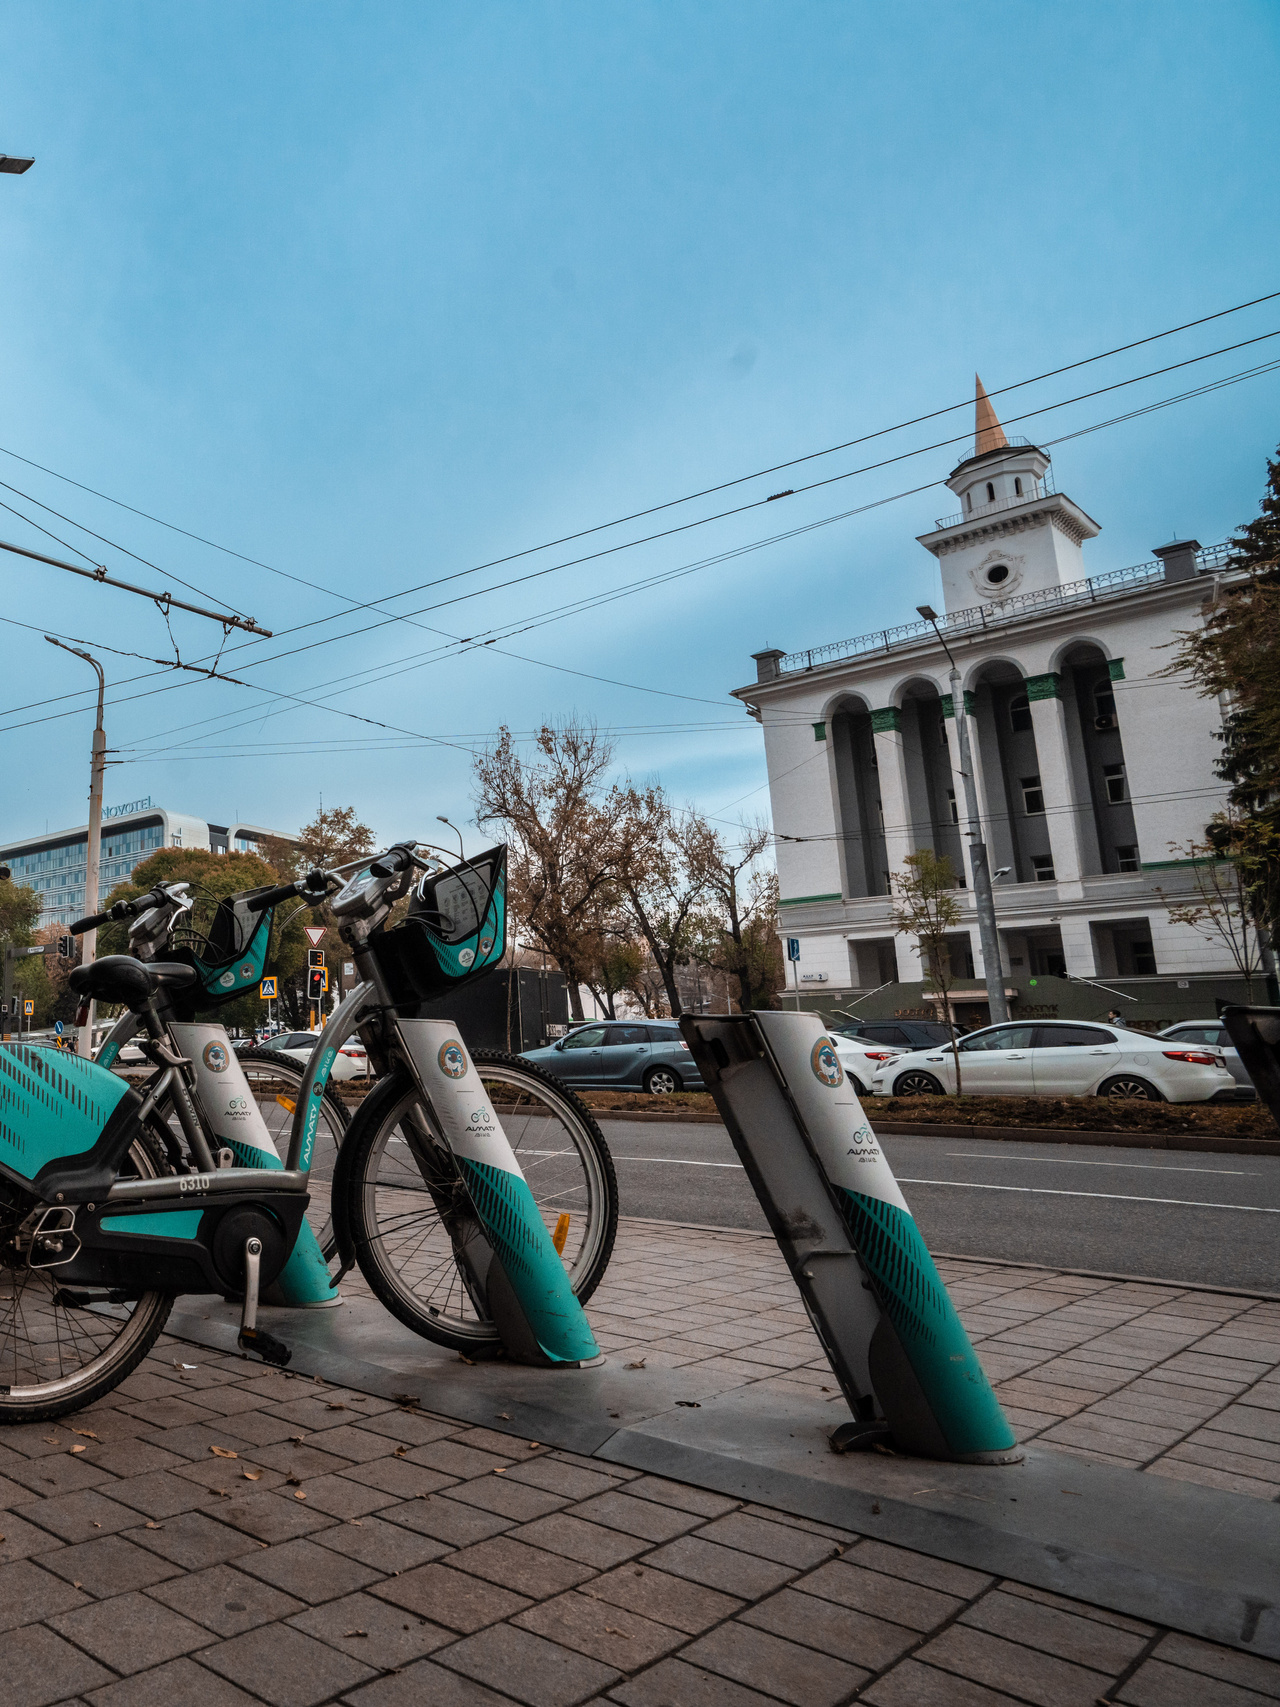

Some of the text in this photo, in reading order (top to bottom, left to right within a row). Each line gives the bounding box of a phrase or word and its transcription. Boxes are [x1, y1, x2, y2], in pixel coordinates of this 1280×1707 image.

[102, 796, 156, 820] NOVOTEL
[317, 953, 323, 965] 3
[303, 1103, 318, 1164] ALMATY
[180, 1175, 210, 1191] 6310
